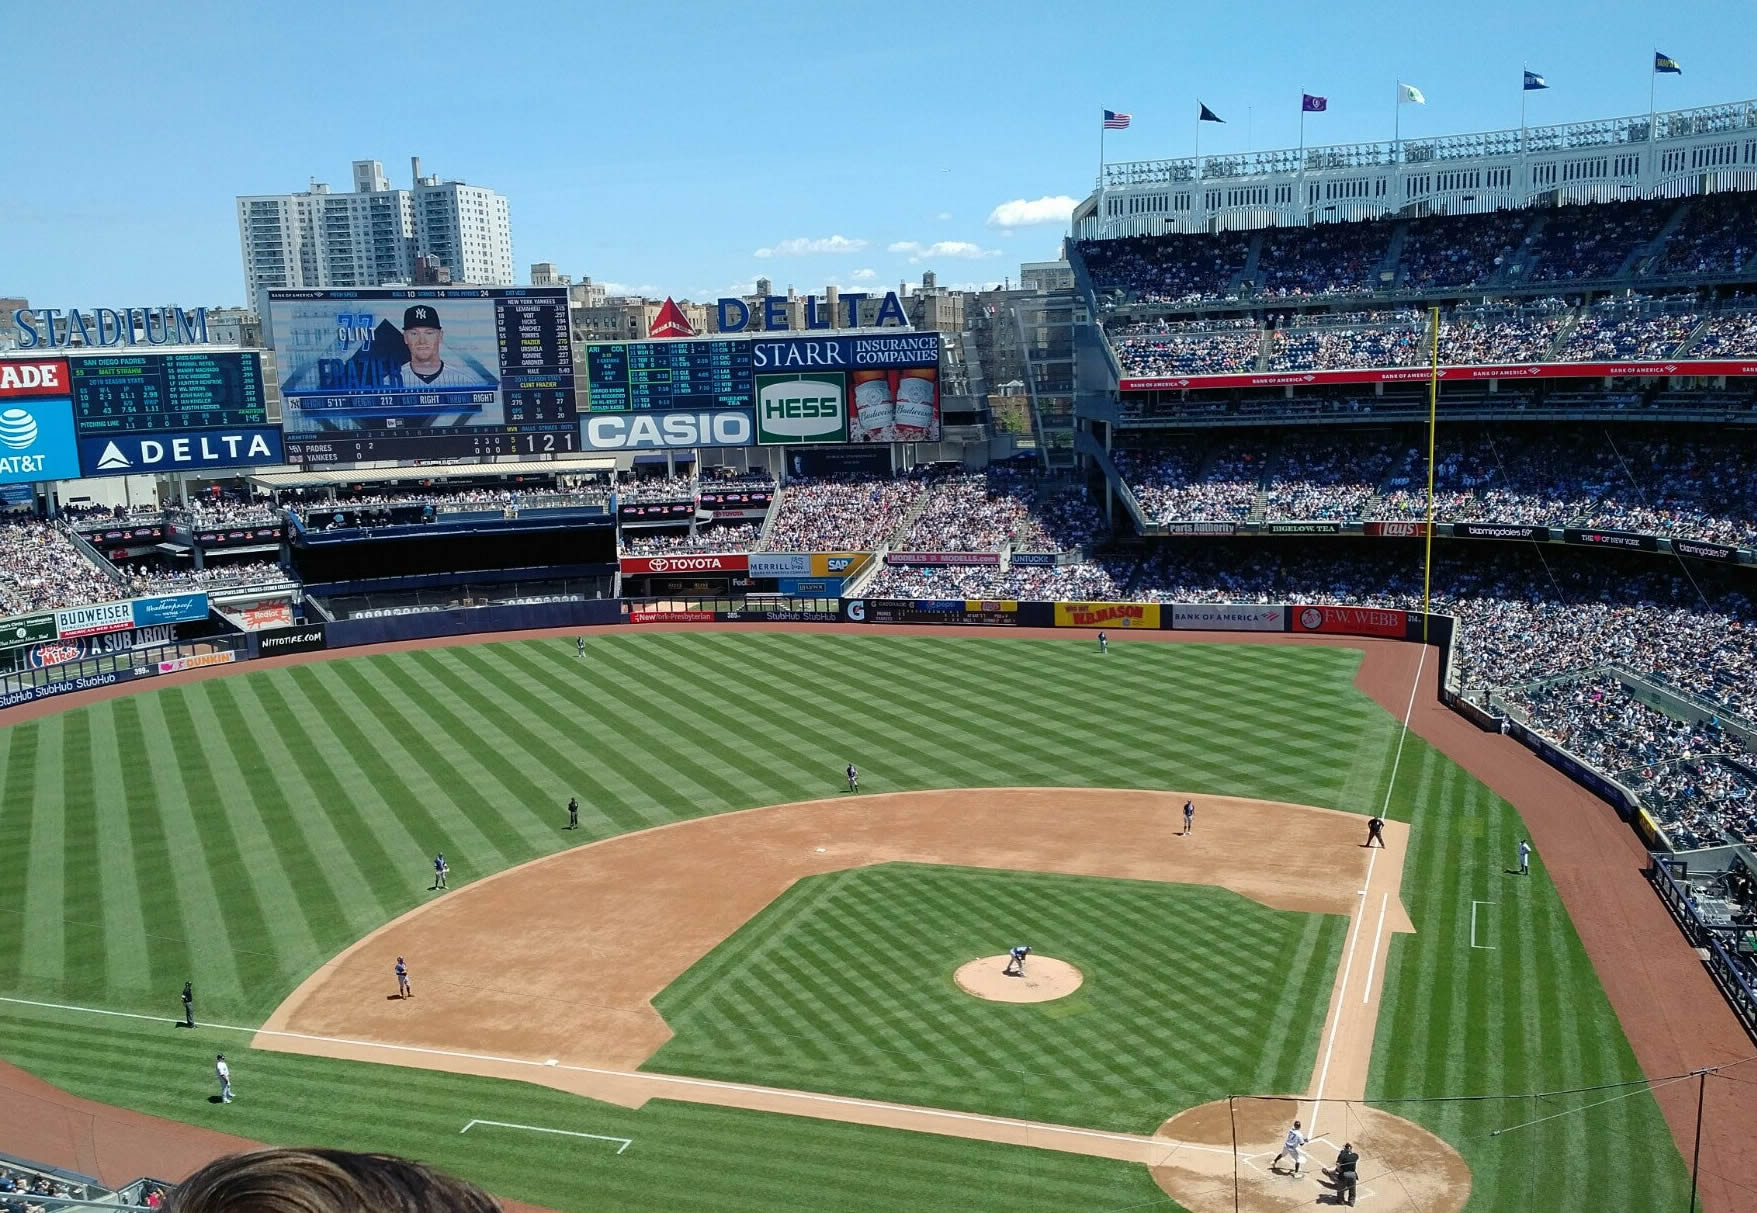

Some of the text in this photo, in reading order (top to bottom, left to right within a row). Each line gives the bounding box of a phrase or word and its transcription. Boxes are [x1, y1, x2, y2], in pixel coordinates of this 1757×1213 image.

[718, 291, 910, 333] DELTA
[13, 307, 210, 347] STADIUM
[338, 327, 376, 341] CLINT
[856, 337, 938, 352] INSURANCE
[753, 342, 847, 367] STARR
[856, 349, 938, 364] COMPANIES
[1, 365, 58, 389] ADE
[381, 396, 393, 406] 212
[419, 395, 440, 404] RIGHT
[473, 393, 494, 403] RIGHT
[766, 397, 838, 419] HESS
[588, 411, 750, 448] CASIO
[140, 434, 271, 464] DELTA
[305, 444, 332, 452] PADRES
[526, 435, 534, 452] 1
[543, 434, 555, 451] 2
[564, 433, 572, 450] 1
[0, 455, 45, 473] AT&T
[306, 453, 338, 462] YANKEES
[1169, 523, 1235, 533] Parts Authority
[1582, 534, 1594, 542] THE
[1625, 538, 1640, 546] YORK
[670, 558, 721, 570] TOYOTA
[750, 562, 789, 570] MERRILL
[828, 560, 849, 570] SAP
[941, 554, 996, 562] MODELLS.com
[61, 604, 129, 626] BUDWEISER
[766, 611, 837, 621] StubHub StubHub
[847, 600, 865, 621] G
[1202, 613, 1214, 621] OF
[1325, 609, 1399, 626] F.W. WEBB
[91, 624, 179, 655] A SUB ABOVE
[261, 632, 322, 648] NITTOTIRE.COM
[186, 652, 234, 667] DUNKIN'
[35, 681, 73, 698] StubHub
[76, 673, 116, 689] StubHub
